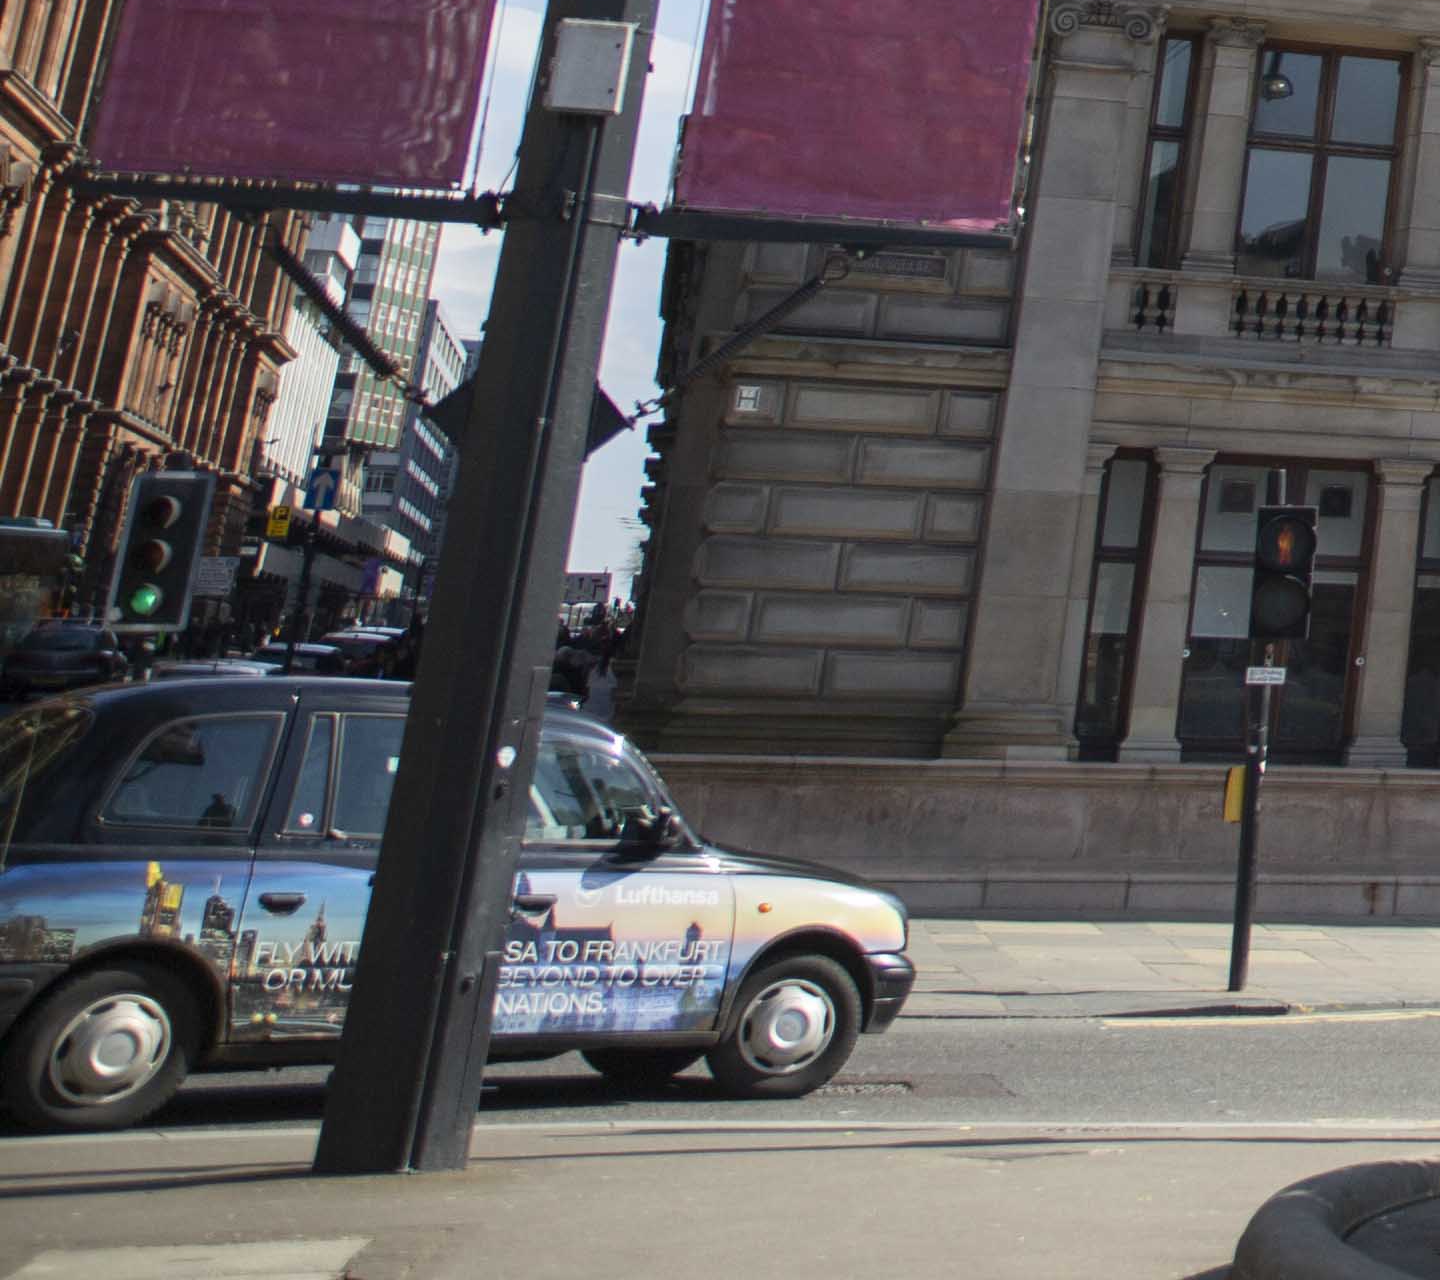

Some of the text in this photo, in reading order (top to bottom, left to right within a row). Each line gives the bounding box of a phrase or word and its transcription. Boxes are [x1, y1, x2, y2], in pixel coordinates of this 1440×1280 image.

[616, 885, 719, 904] Lufthansa
[256, 940, 724, 963] FLY WIT SA TO FRANKFURT
[264, 965, 705, 990] OR MU BEYOND TO OVER
[493, 992, 607, 1016] NATIONS.
